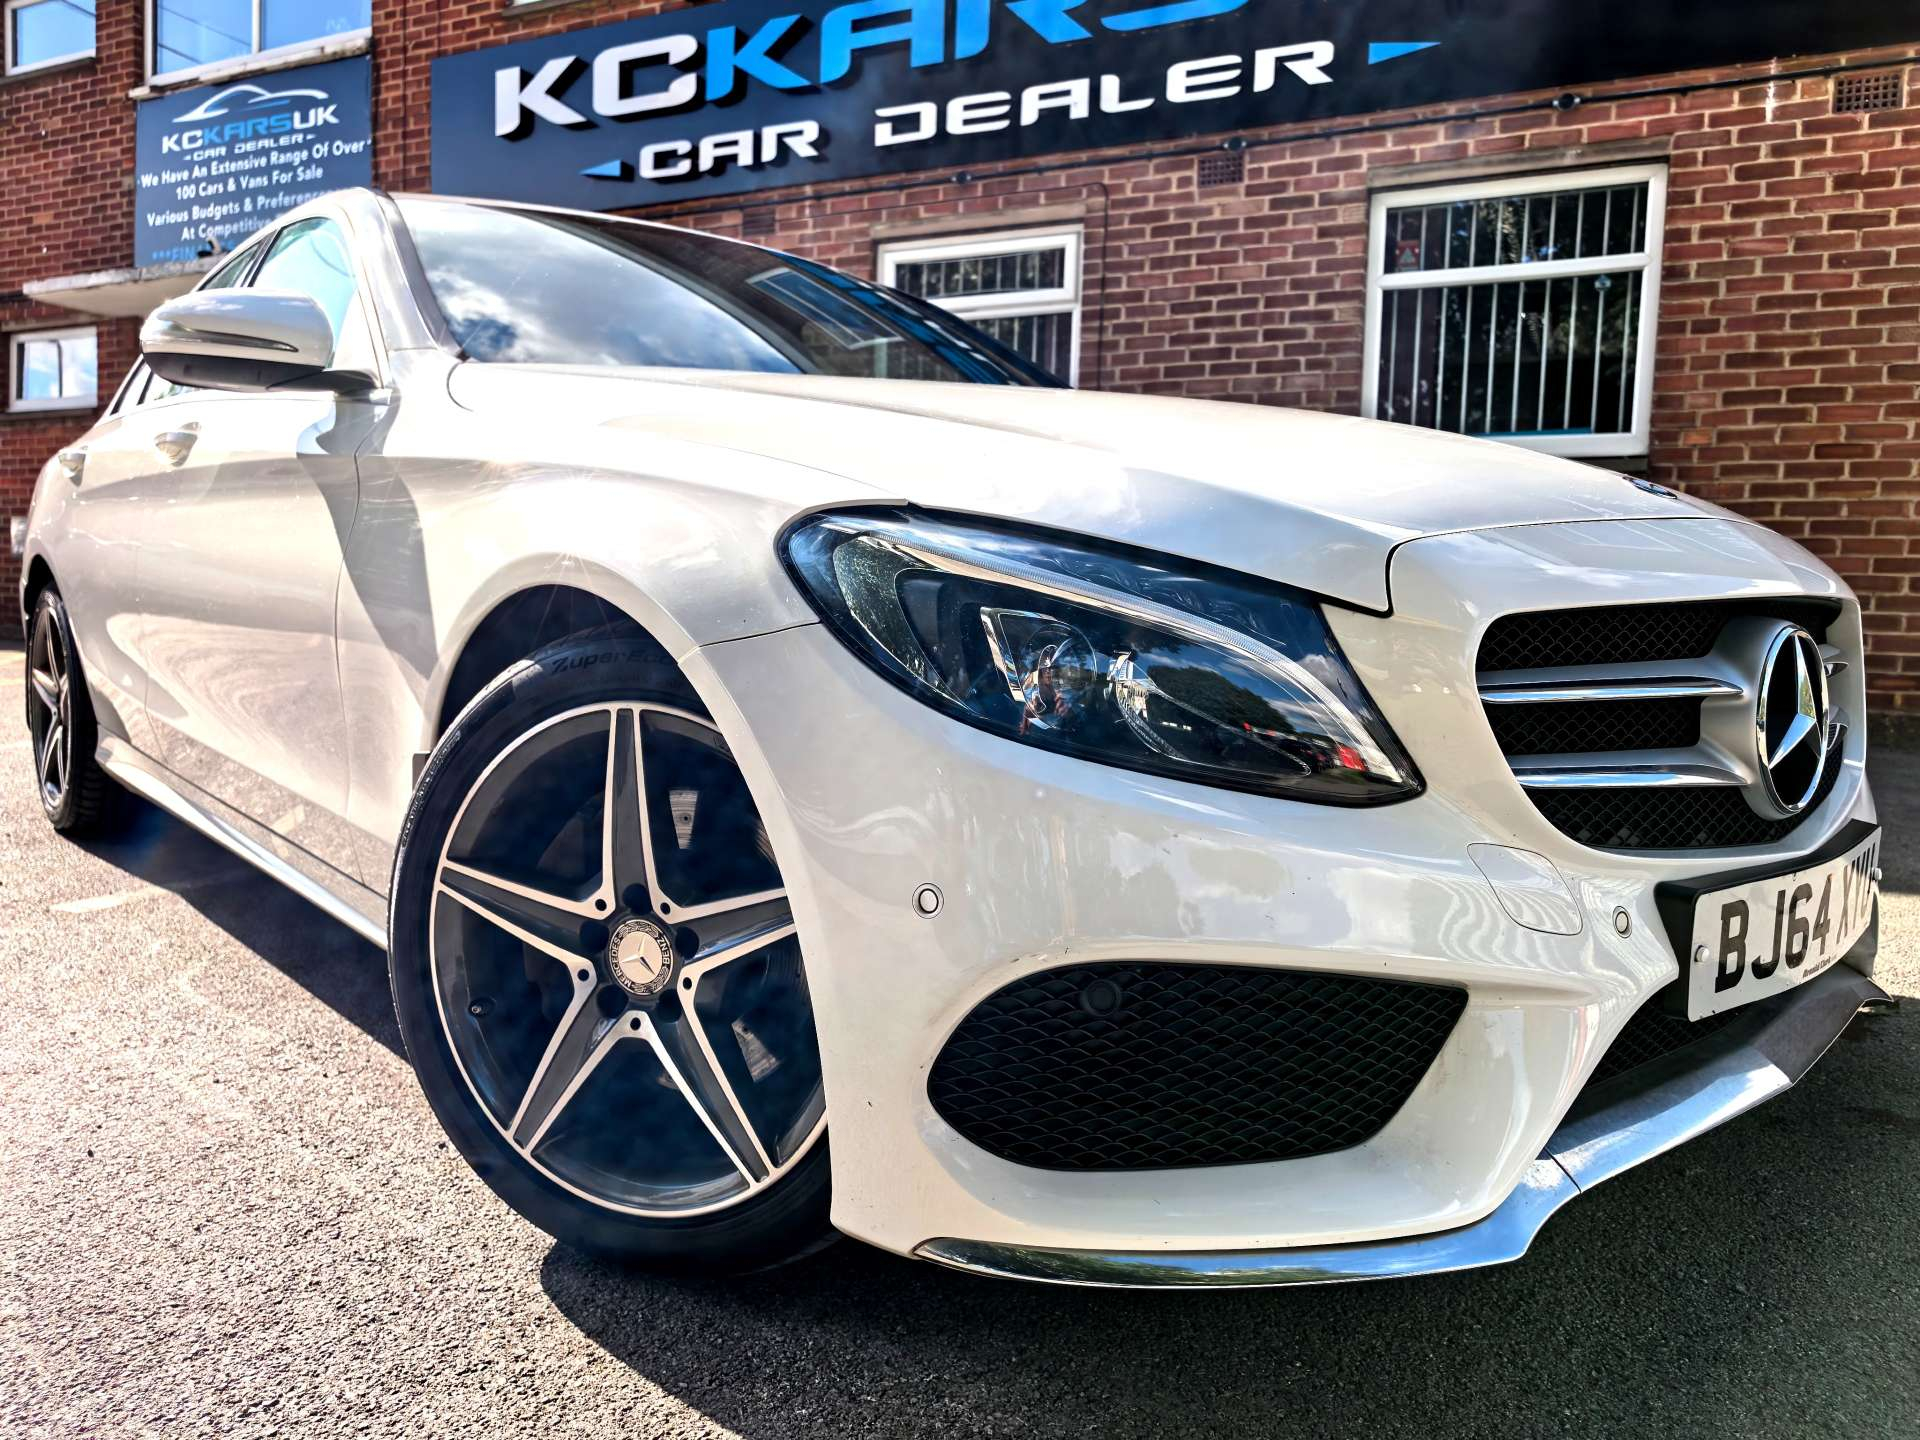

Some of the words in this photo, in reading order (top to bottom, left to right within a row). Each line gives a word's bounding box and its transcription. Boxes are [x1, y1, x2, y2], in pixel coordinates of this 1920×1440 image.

[162, 104, 339, 154] KCKARSUK
[639, 120, 820, 179] CAR
[874, 40, 1334, 147] DEALER
[141, 173, 159, 188] We
[161, 169, 189, 185] Have
[192, 164, 208, 179] An
[211, 154, 267, 176] Extensive
[270, 150, 308, 166] Range
[312, 141, 329, 159] Of
[332, 140, 365, 156] Over
[193, 146, 226, 161] CAR
[234, 133, 304, 154] DEALER
[176, 184, 196, 200] 100
[199, 181, 224, 197] Cars
[227, 177, 236, 192] &
[240, 175, 268, 190] Vans
[272, 169, 293, 185] For
[296, 163, 323, 182] Sale
[147, 210, 189, 227] Various
[192, 202, 240, 221] Budgets
[244, 196, 253, 213] &
[181, 226, 195, 241] At
[657, 937, 671, 965] BENZ
[1714, 873, 1832, 994] BJ64
[611, 937, 632, 988] MERCEDES
